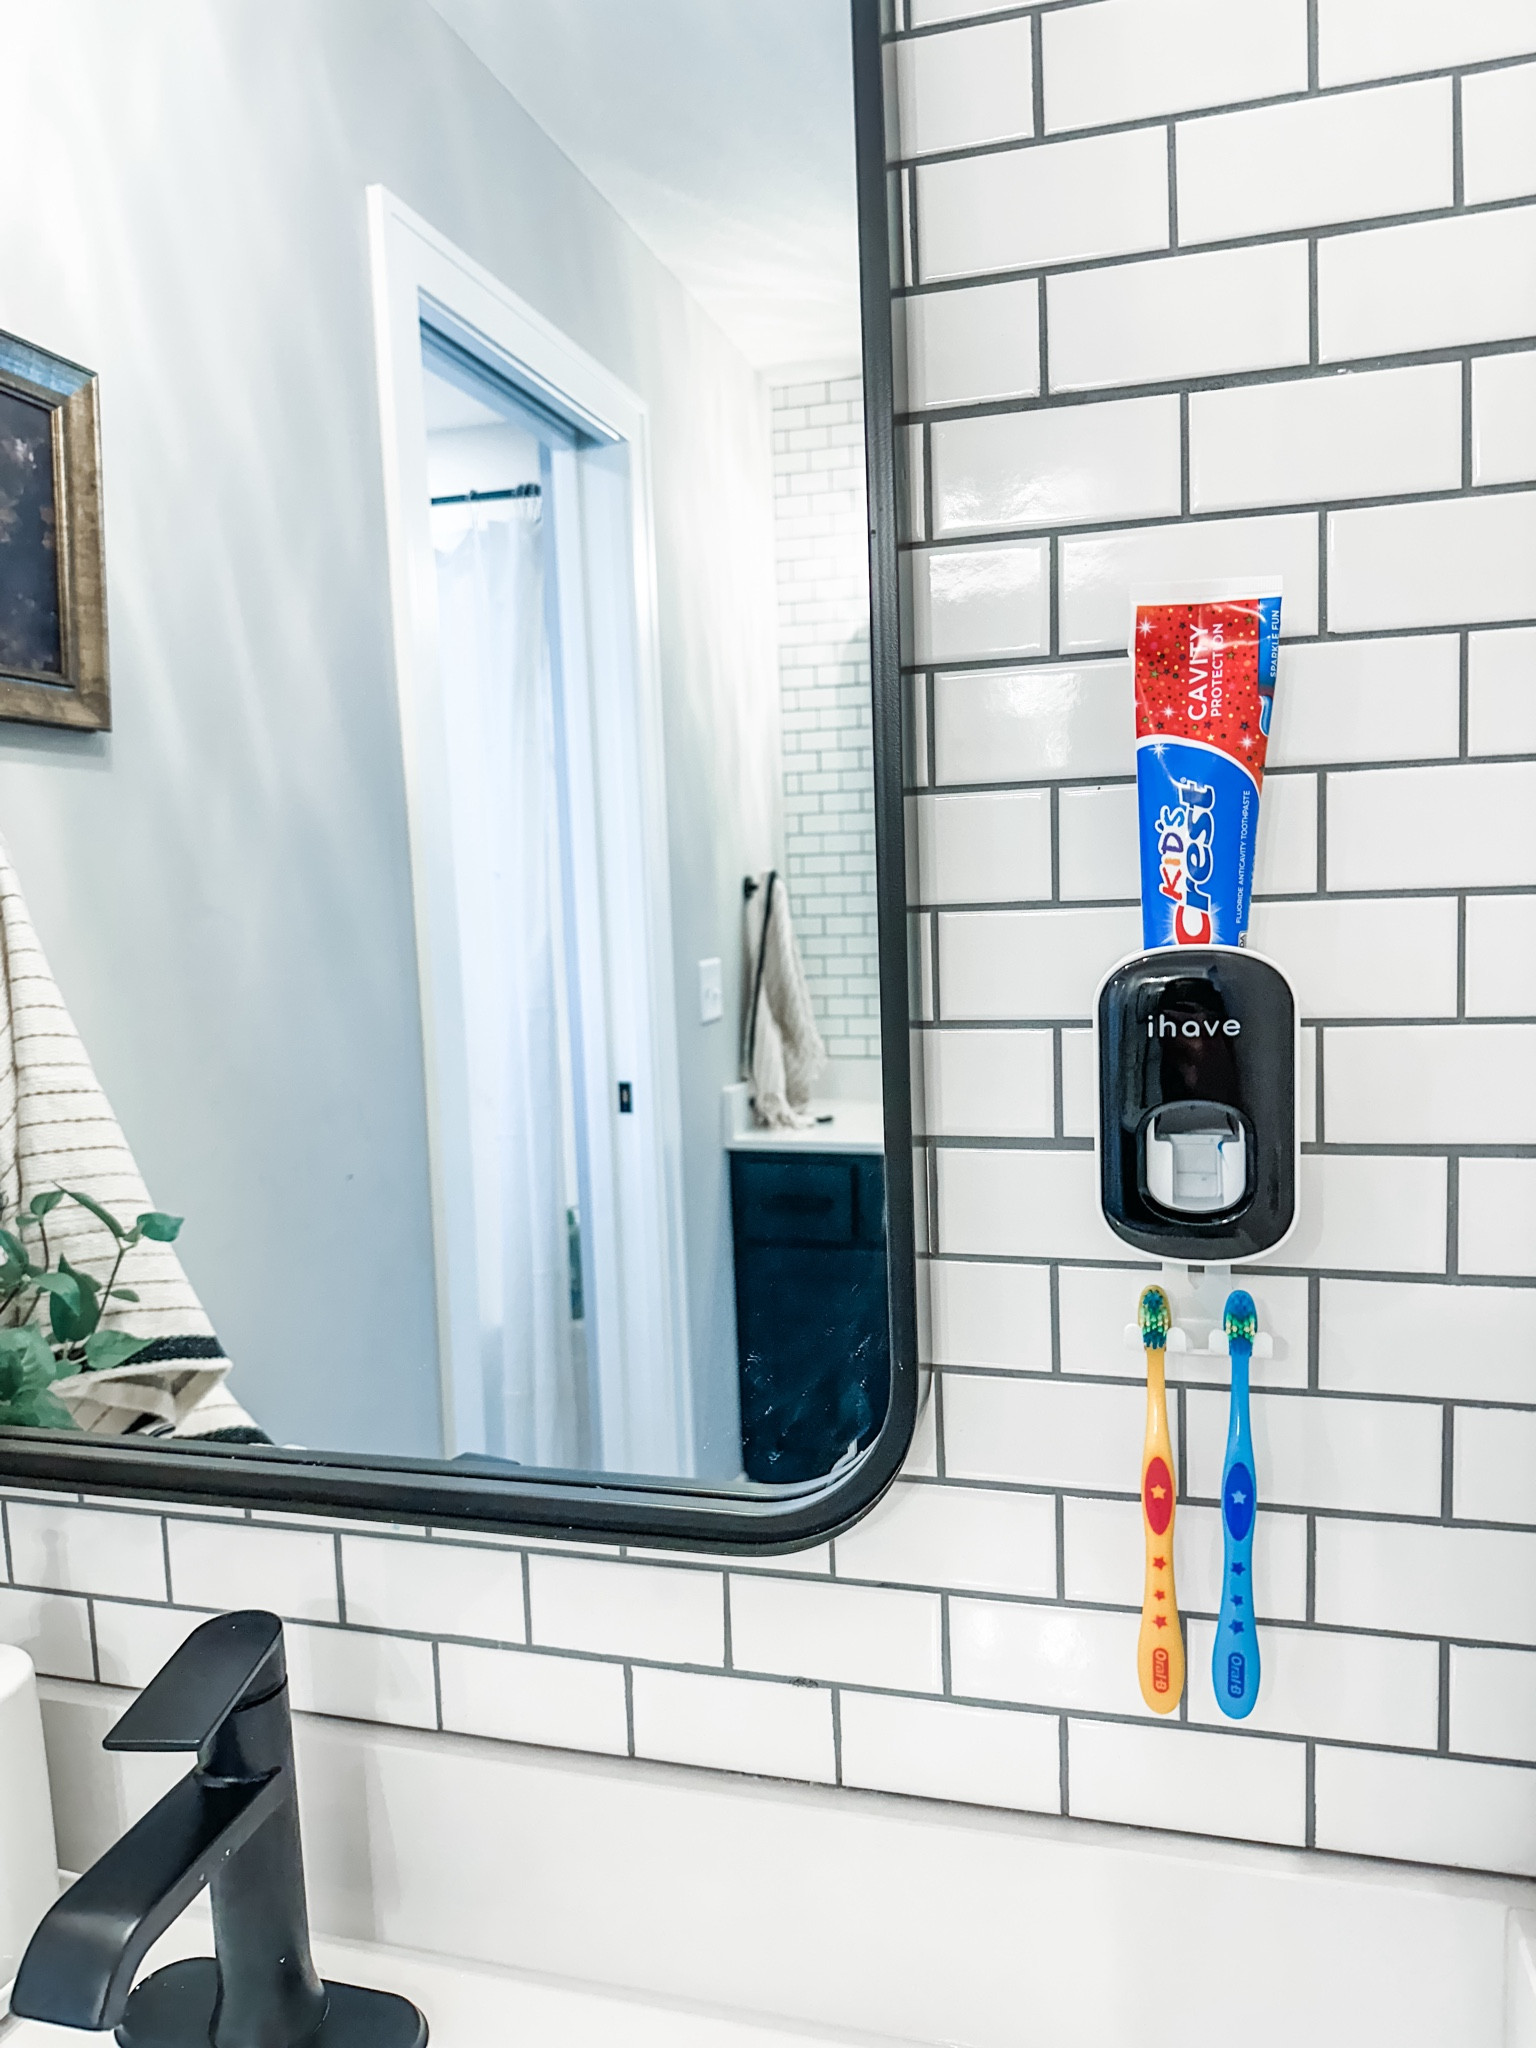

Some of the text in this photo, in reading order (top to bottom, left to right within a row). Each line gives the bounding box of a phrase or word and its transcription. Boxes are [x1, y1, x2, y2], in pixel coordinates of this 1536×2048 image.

[1188, 624, 1209, 720] CAVITY
[1270, 610, 1280, 678] SPARKLE FUN
[1156, 808, 1186, 901] KID'S
[1174, 781, 1216, 945] Crest
[1236, 790, 1250, 924] FLUORIDE ANTICAVITY TOOTHPASTE
[1147, 1014, 1241, 1038] ihave
